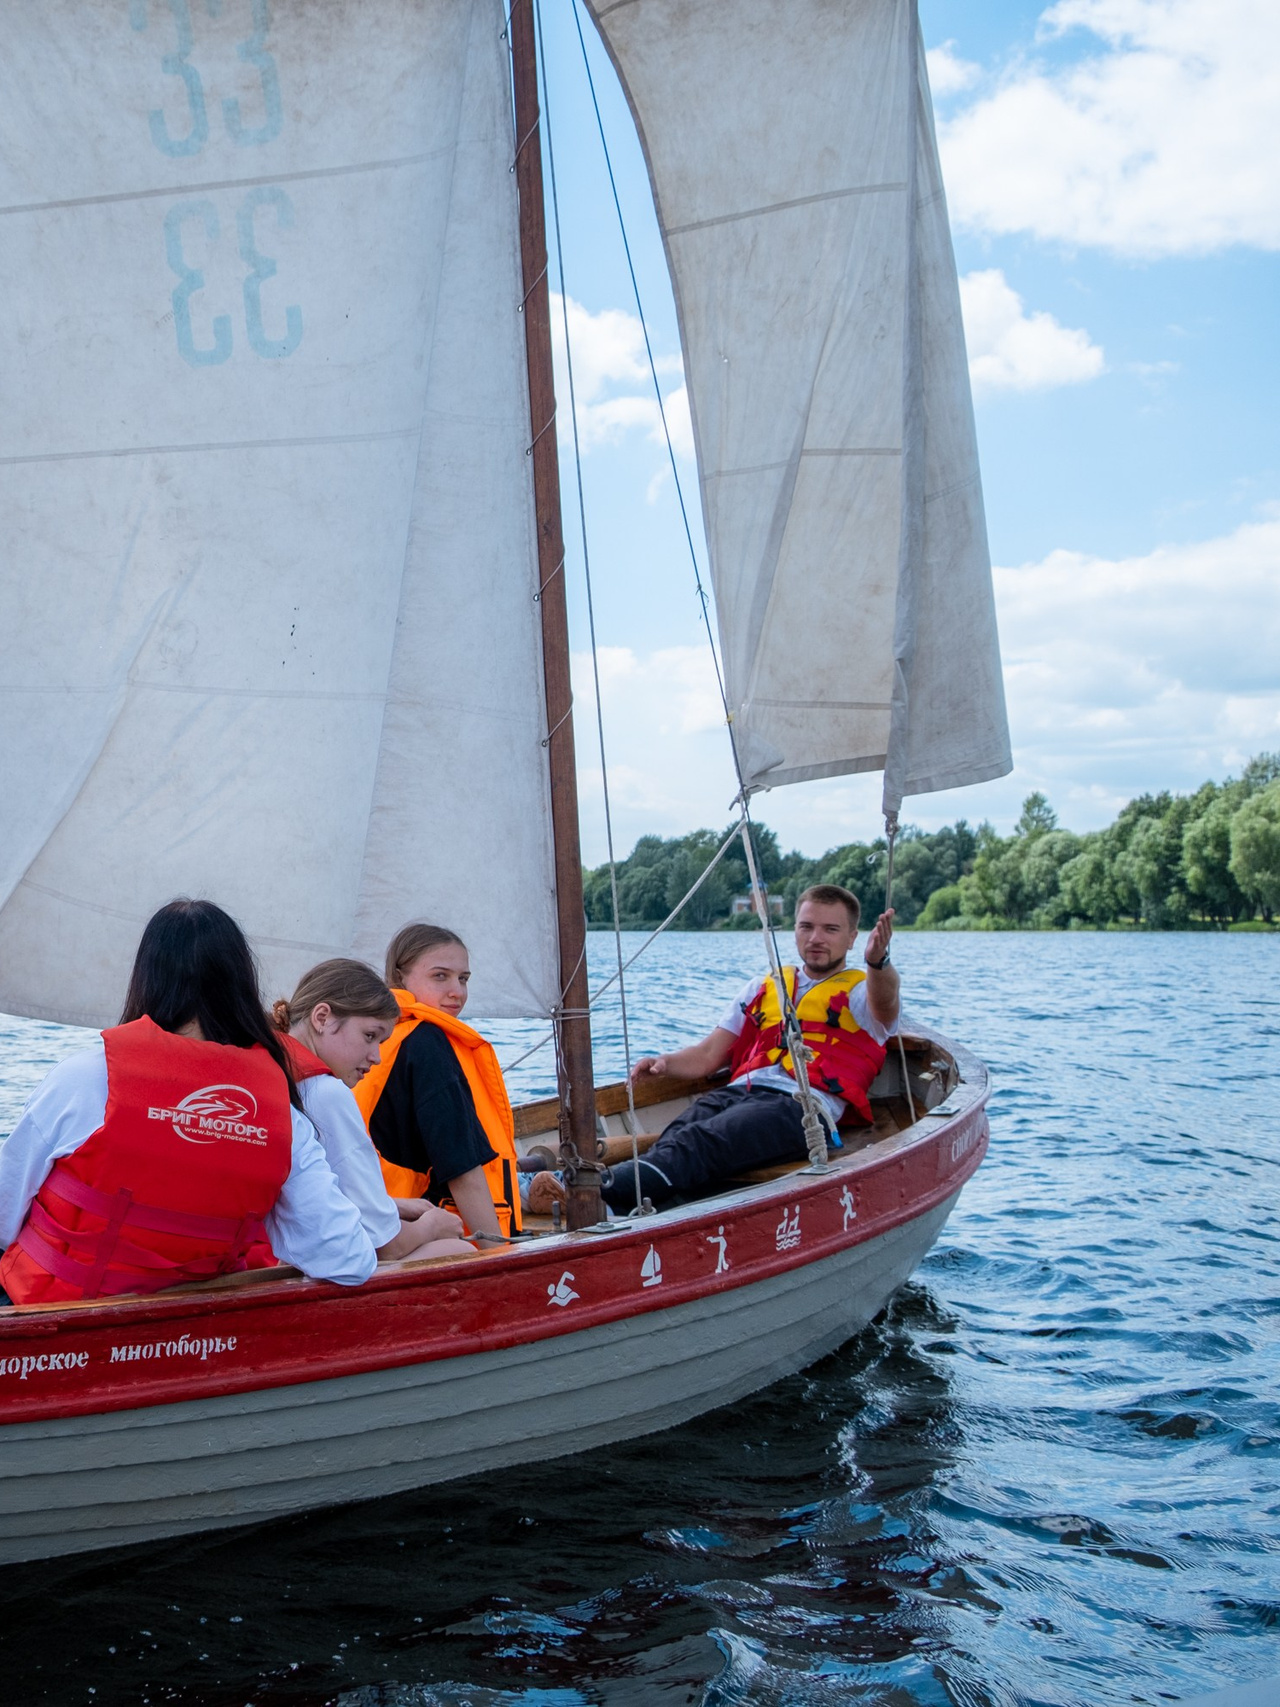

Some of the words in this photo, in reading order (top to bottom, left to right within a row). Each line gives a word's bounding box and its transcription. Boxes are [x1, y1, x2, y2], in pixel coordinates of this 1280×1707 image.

[129, 0, 283, 157] 33
[148, 1107, 198, 1125] БРИГ
[199, 1118, 268, 1139] МОТОРС
[184, 1127, 267, 1146] www.brig-motors.com
[109, 1333, 237, 1363] многоборье
